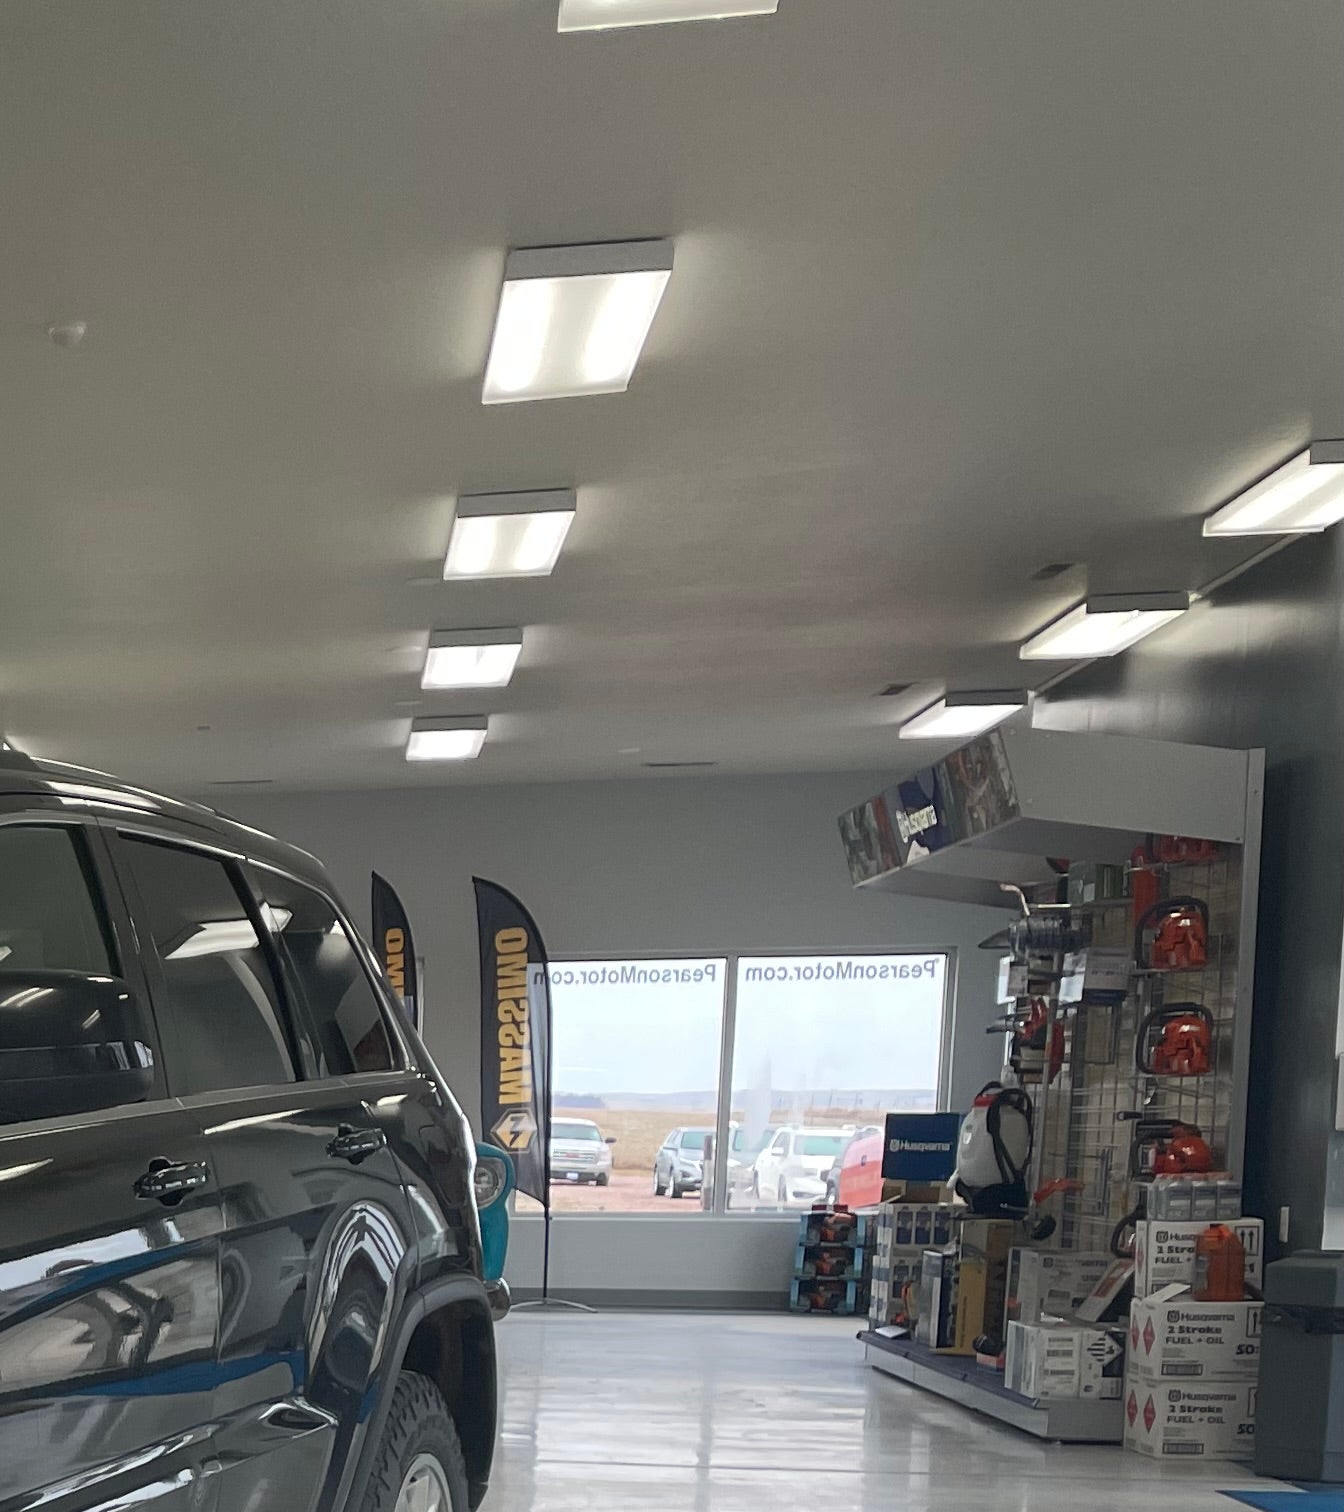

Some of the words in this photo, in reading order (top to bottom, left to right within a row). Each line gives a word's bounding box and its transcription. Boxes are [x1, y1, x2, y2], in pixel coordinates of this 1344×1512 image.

[1167, 1245, 1195, 1254] Stro
[1178, 1325, 1222, 1334] Stroke
[1165, 1336, 1194, 1345] FUEL
[1206, 1336, 1224, 1345] OIL
[1235, 1343, 1260, 1356] 50:
[1179, 1404, 1223, 1414] Stroke
[1167, 1416, 1195, 1424] FUEL
[1207, 1416, 1226, 1424] OIL
[1237, 1423, 1255, 1435] 50
